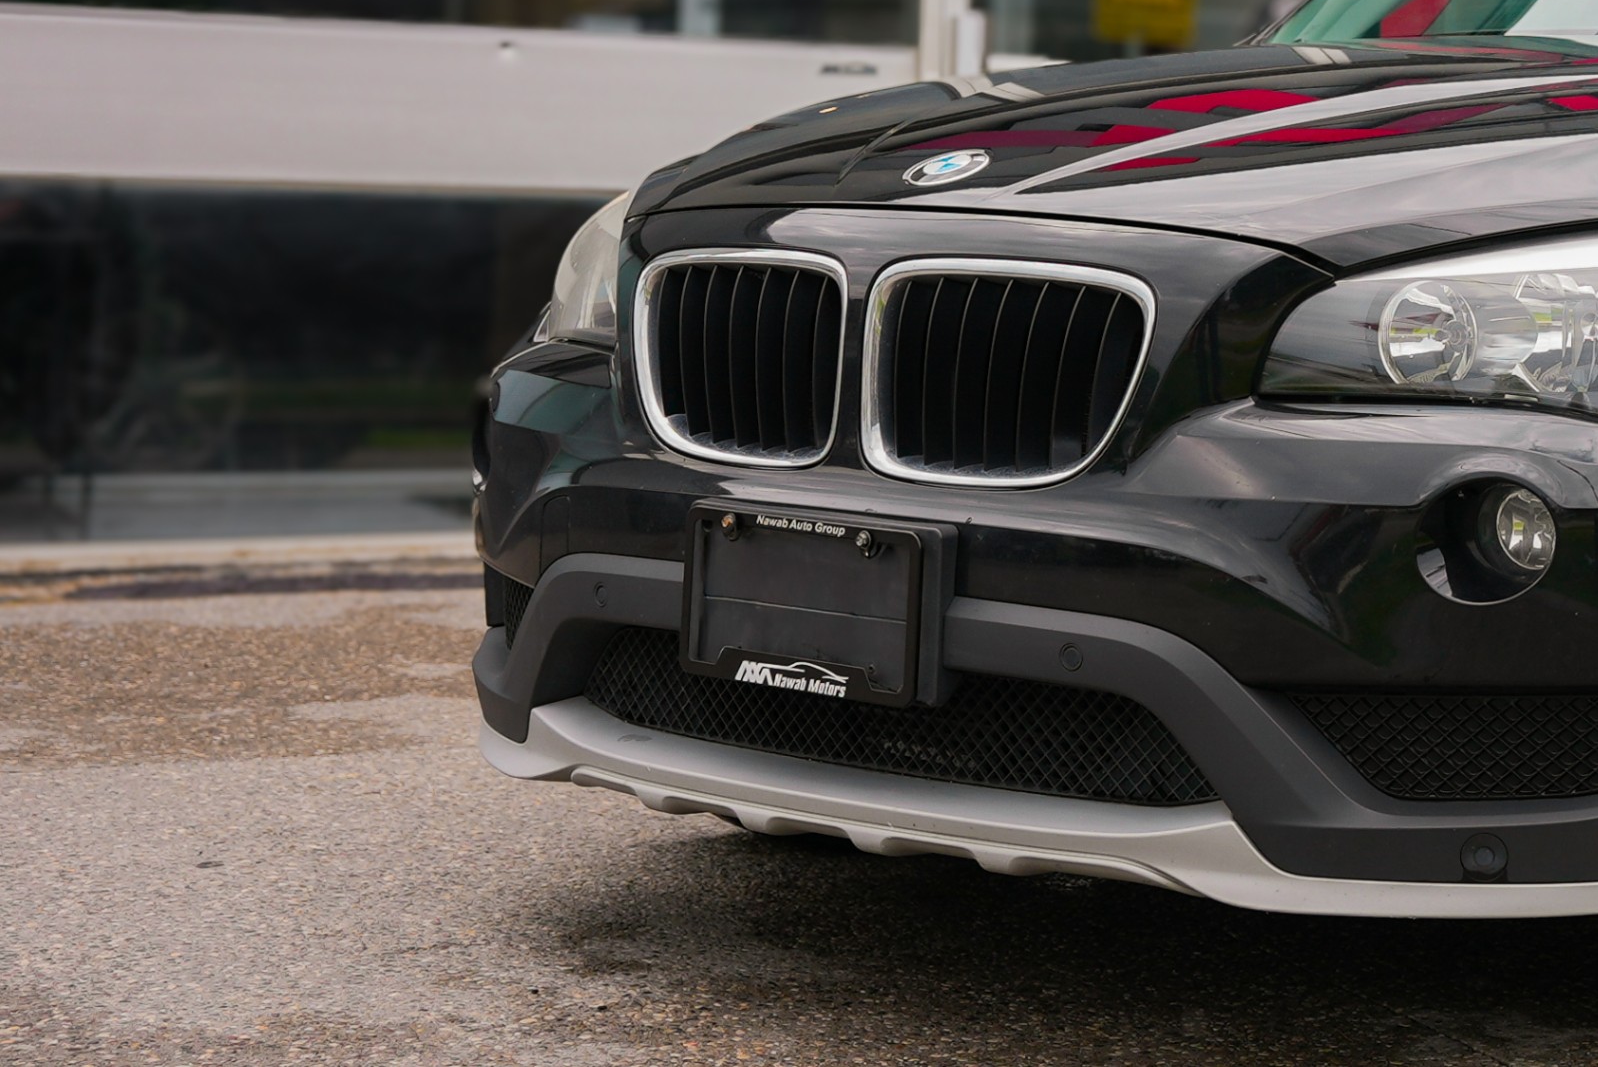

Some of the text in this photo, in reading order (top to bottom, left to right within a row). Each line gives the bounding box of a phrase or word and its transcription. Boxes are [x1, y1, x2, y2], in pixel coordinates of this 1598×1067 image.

[756, 514, 846, 537] Nawab Auto Group
[773, 673, 807, 691] Nawab
[807, 678, 846, 698] Motors
